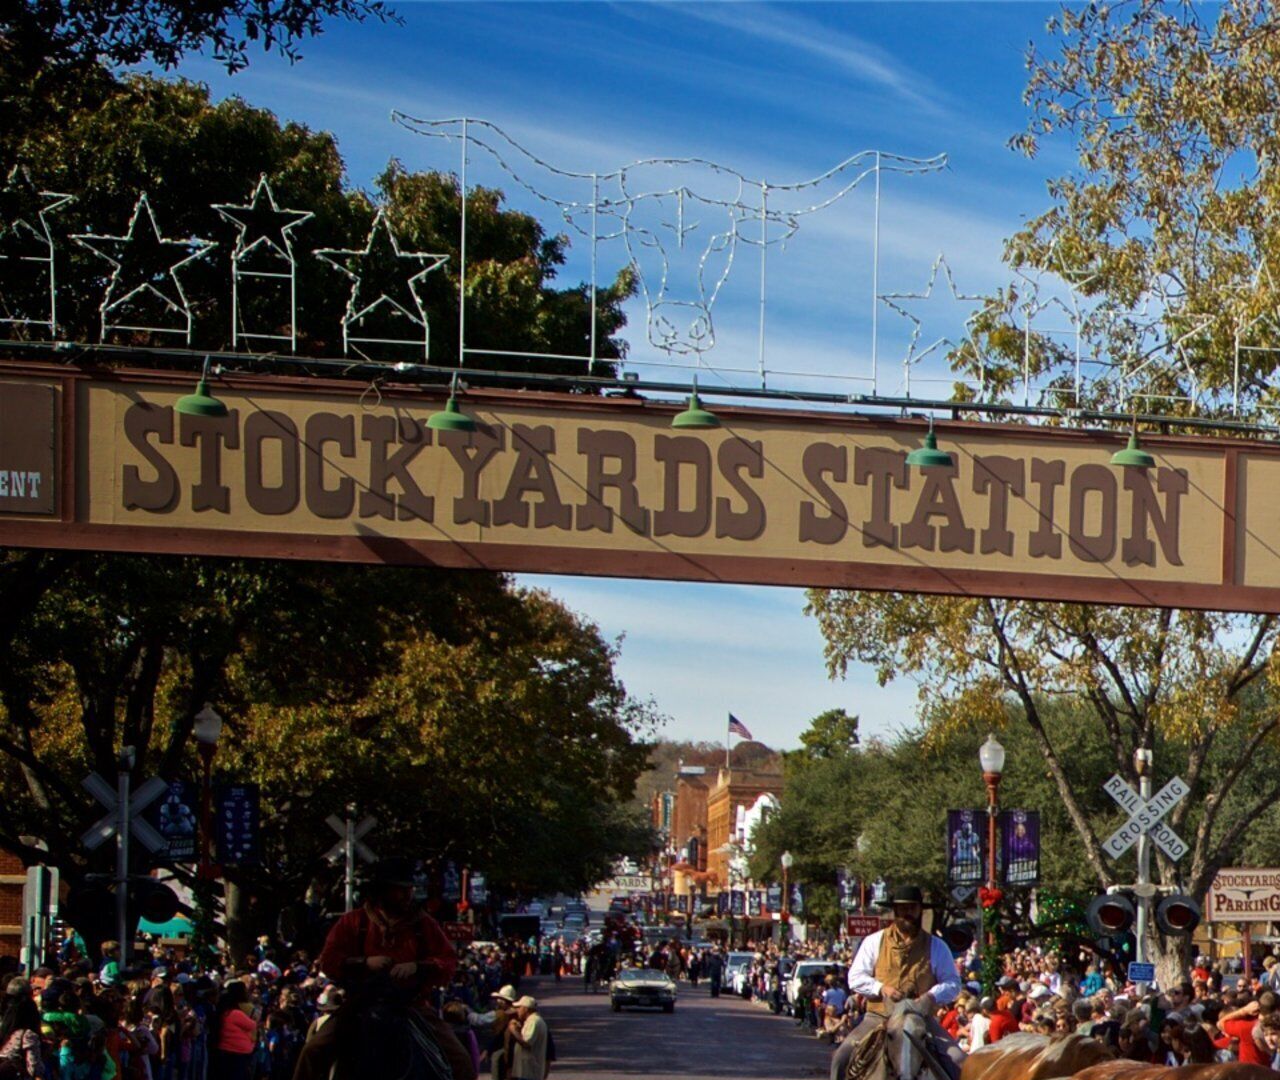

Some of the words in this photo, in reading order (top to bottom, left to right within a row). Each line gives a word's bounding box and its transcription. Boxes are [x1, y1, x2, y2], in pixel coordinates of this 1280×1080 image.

[122, 402, 767, 541] STOCKYARDS
[799, 442, 1189, 568] STATION
[1108, 778, 1138, 812] RAIL
[1111, 783, 1183, 852] CROSSING
[1152, 821, 1184, 858] ROAD
[850, 919, 877, 927] WRONG
